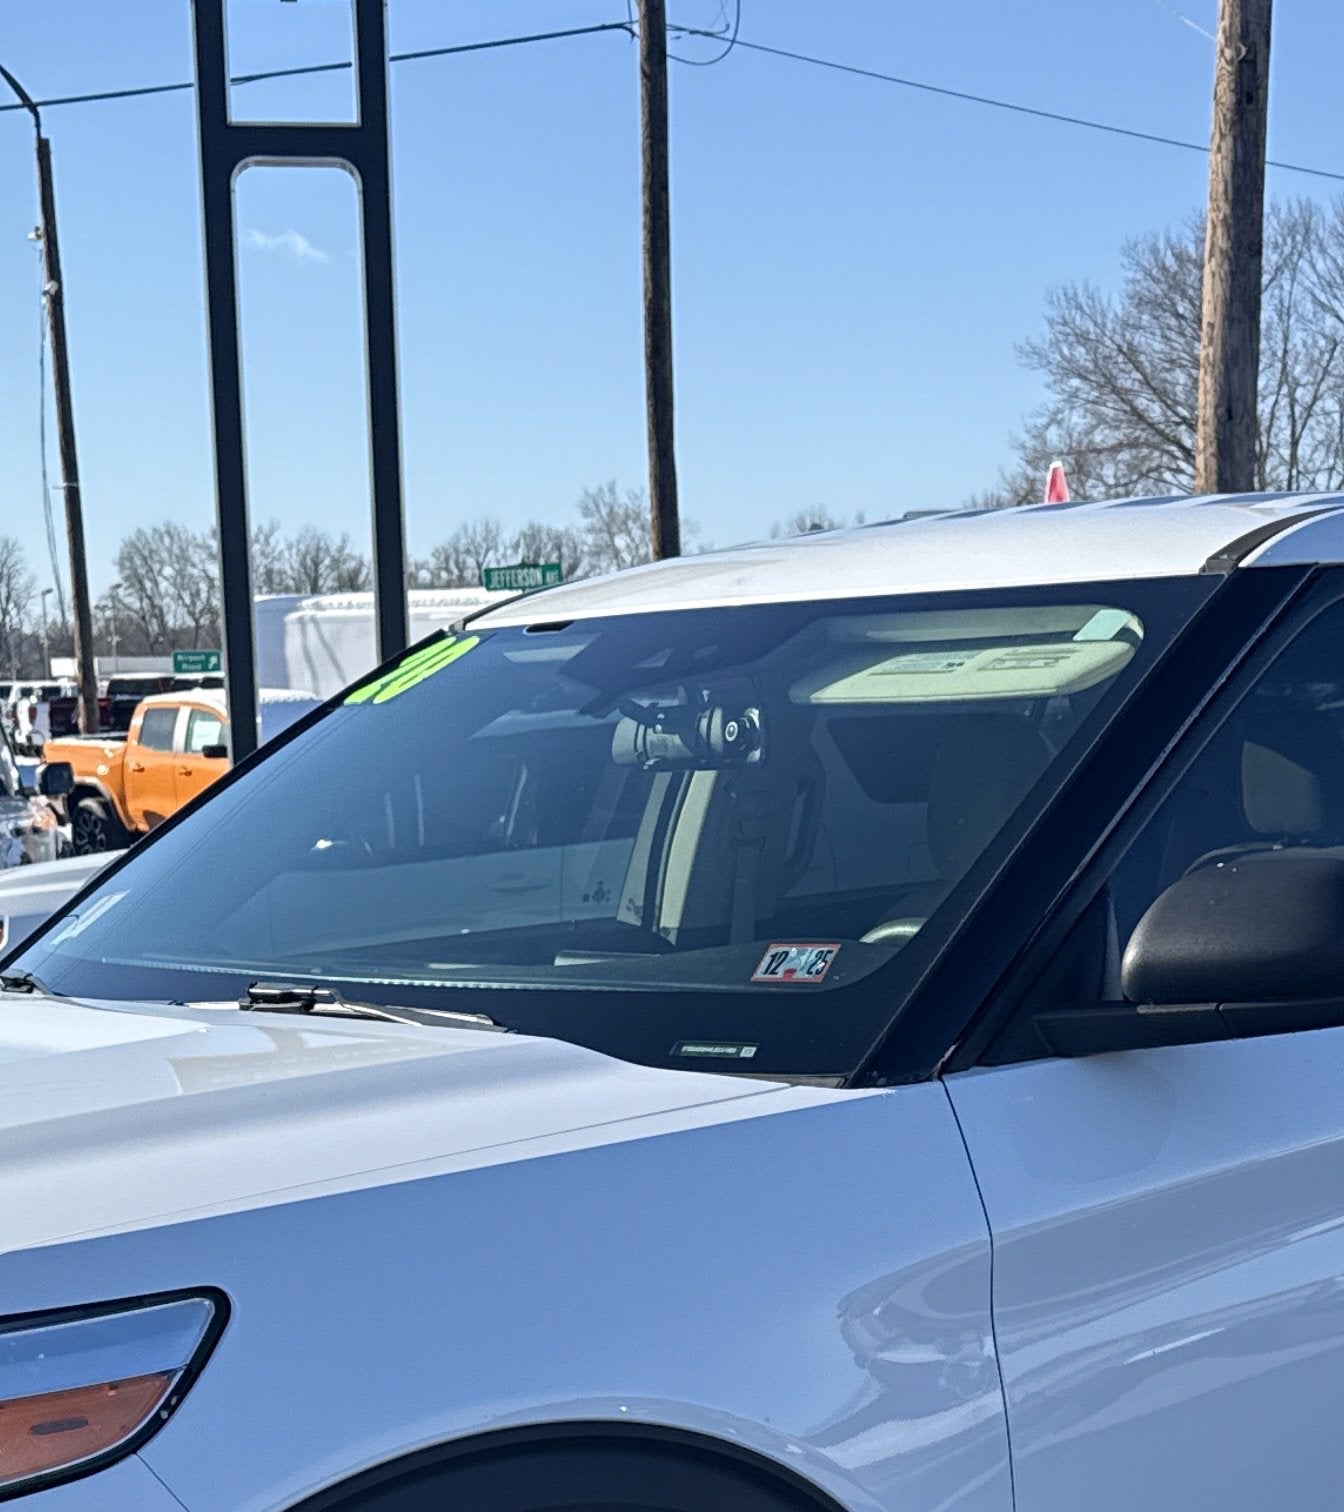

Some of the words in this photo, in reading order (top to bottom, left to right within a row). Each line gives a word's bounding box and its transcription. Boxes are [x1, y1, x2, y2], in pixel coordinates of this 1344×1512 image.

[489, 565, 544, 590] JEFFERSON
[762, 950, 790, 976] 12
[806, 949, 834, 976] 25
